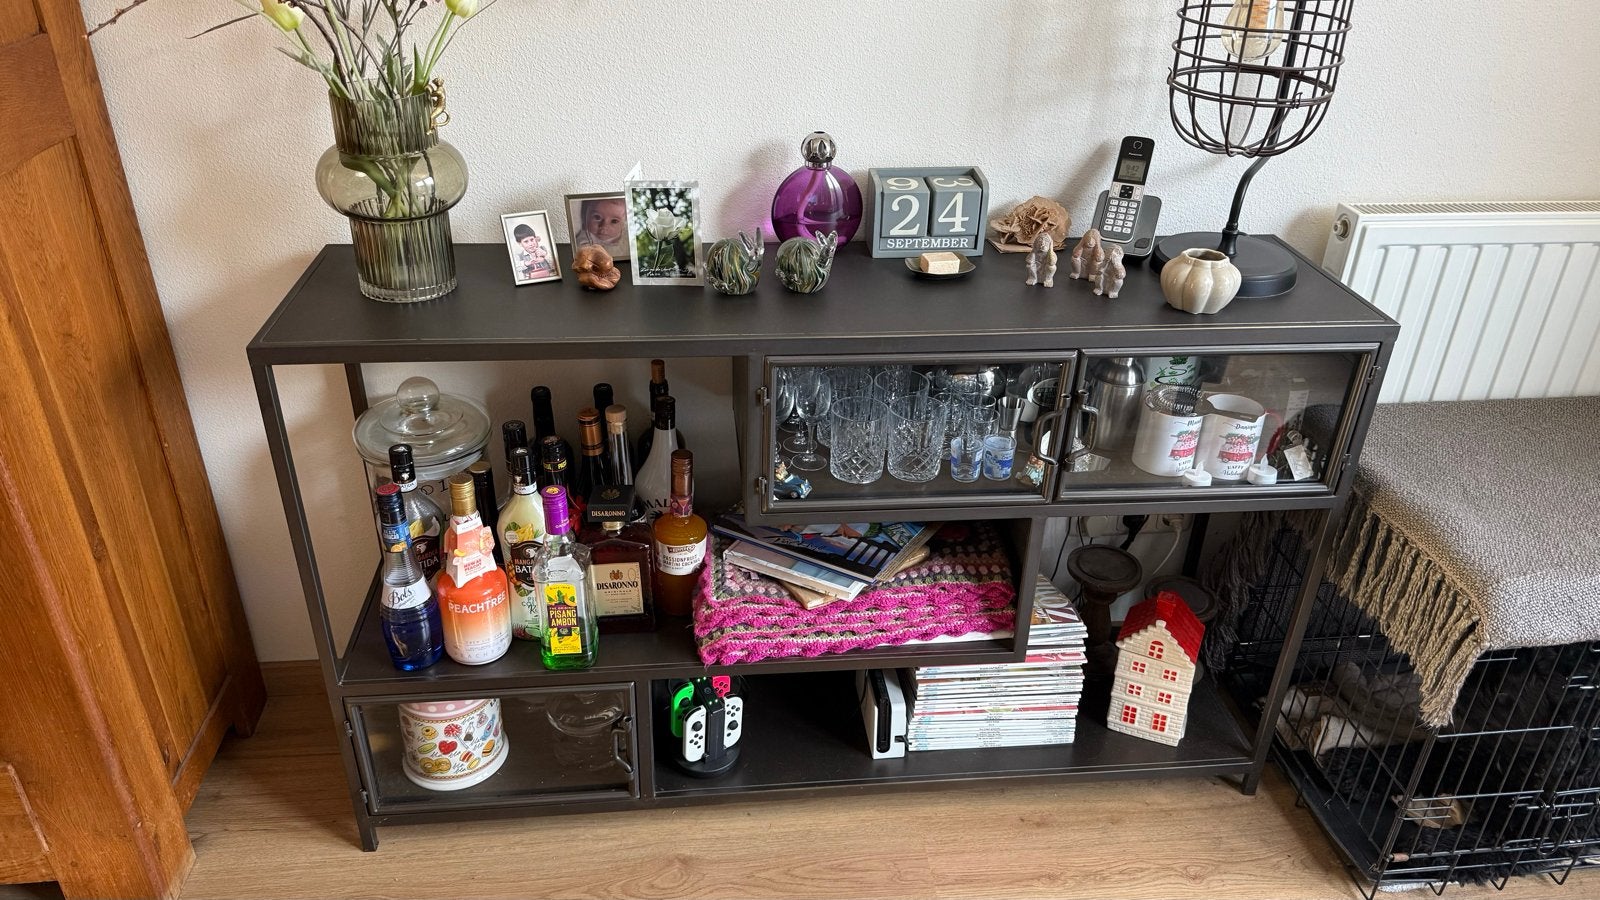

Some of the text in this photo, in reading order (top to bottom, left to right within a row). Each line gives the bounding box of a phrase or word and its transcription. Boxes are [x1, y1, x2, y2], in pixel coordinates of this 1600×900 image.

[886, 177, 919, 191] 9
[886, 238, 969, 249] SEPTEMBER
[643, 498, 671, 509] MAL
[419, 555, 439, 570] TIDA
[515, 564, 532, 574] BAT
[596, 580, 639, 591] DISARONNO
[387, 588, 413, 608] Bols
[448, 590, 506, 614] PEACHTREE
[549, 609, 577, 619] PISANG
[551, 617, 577, 627] AMBON
